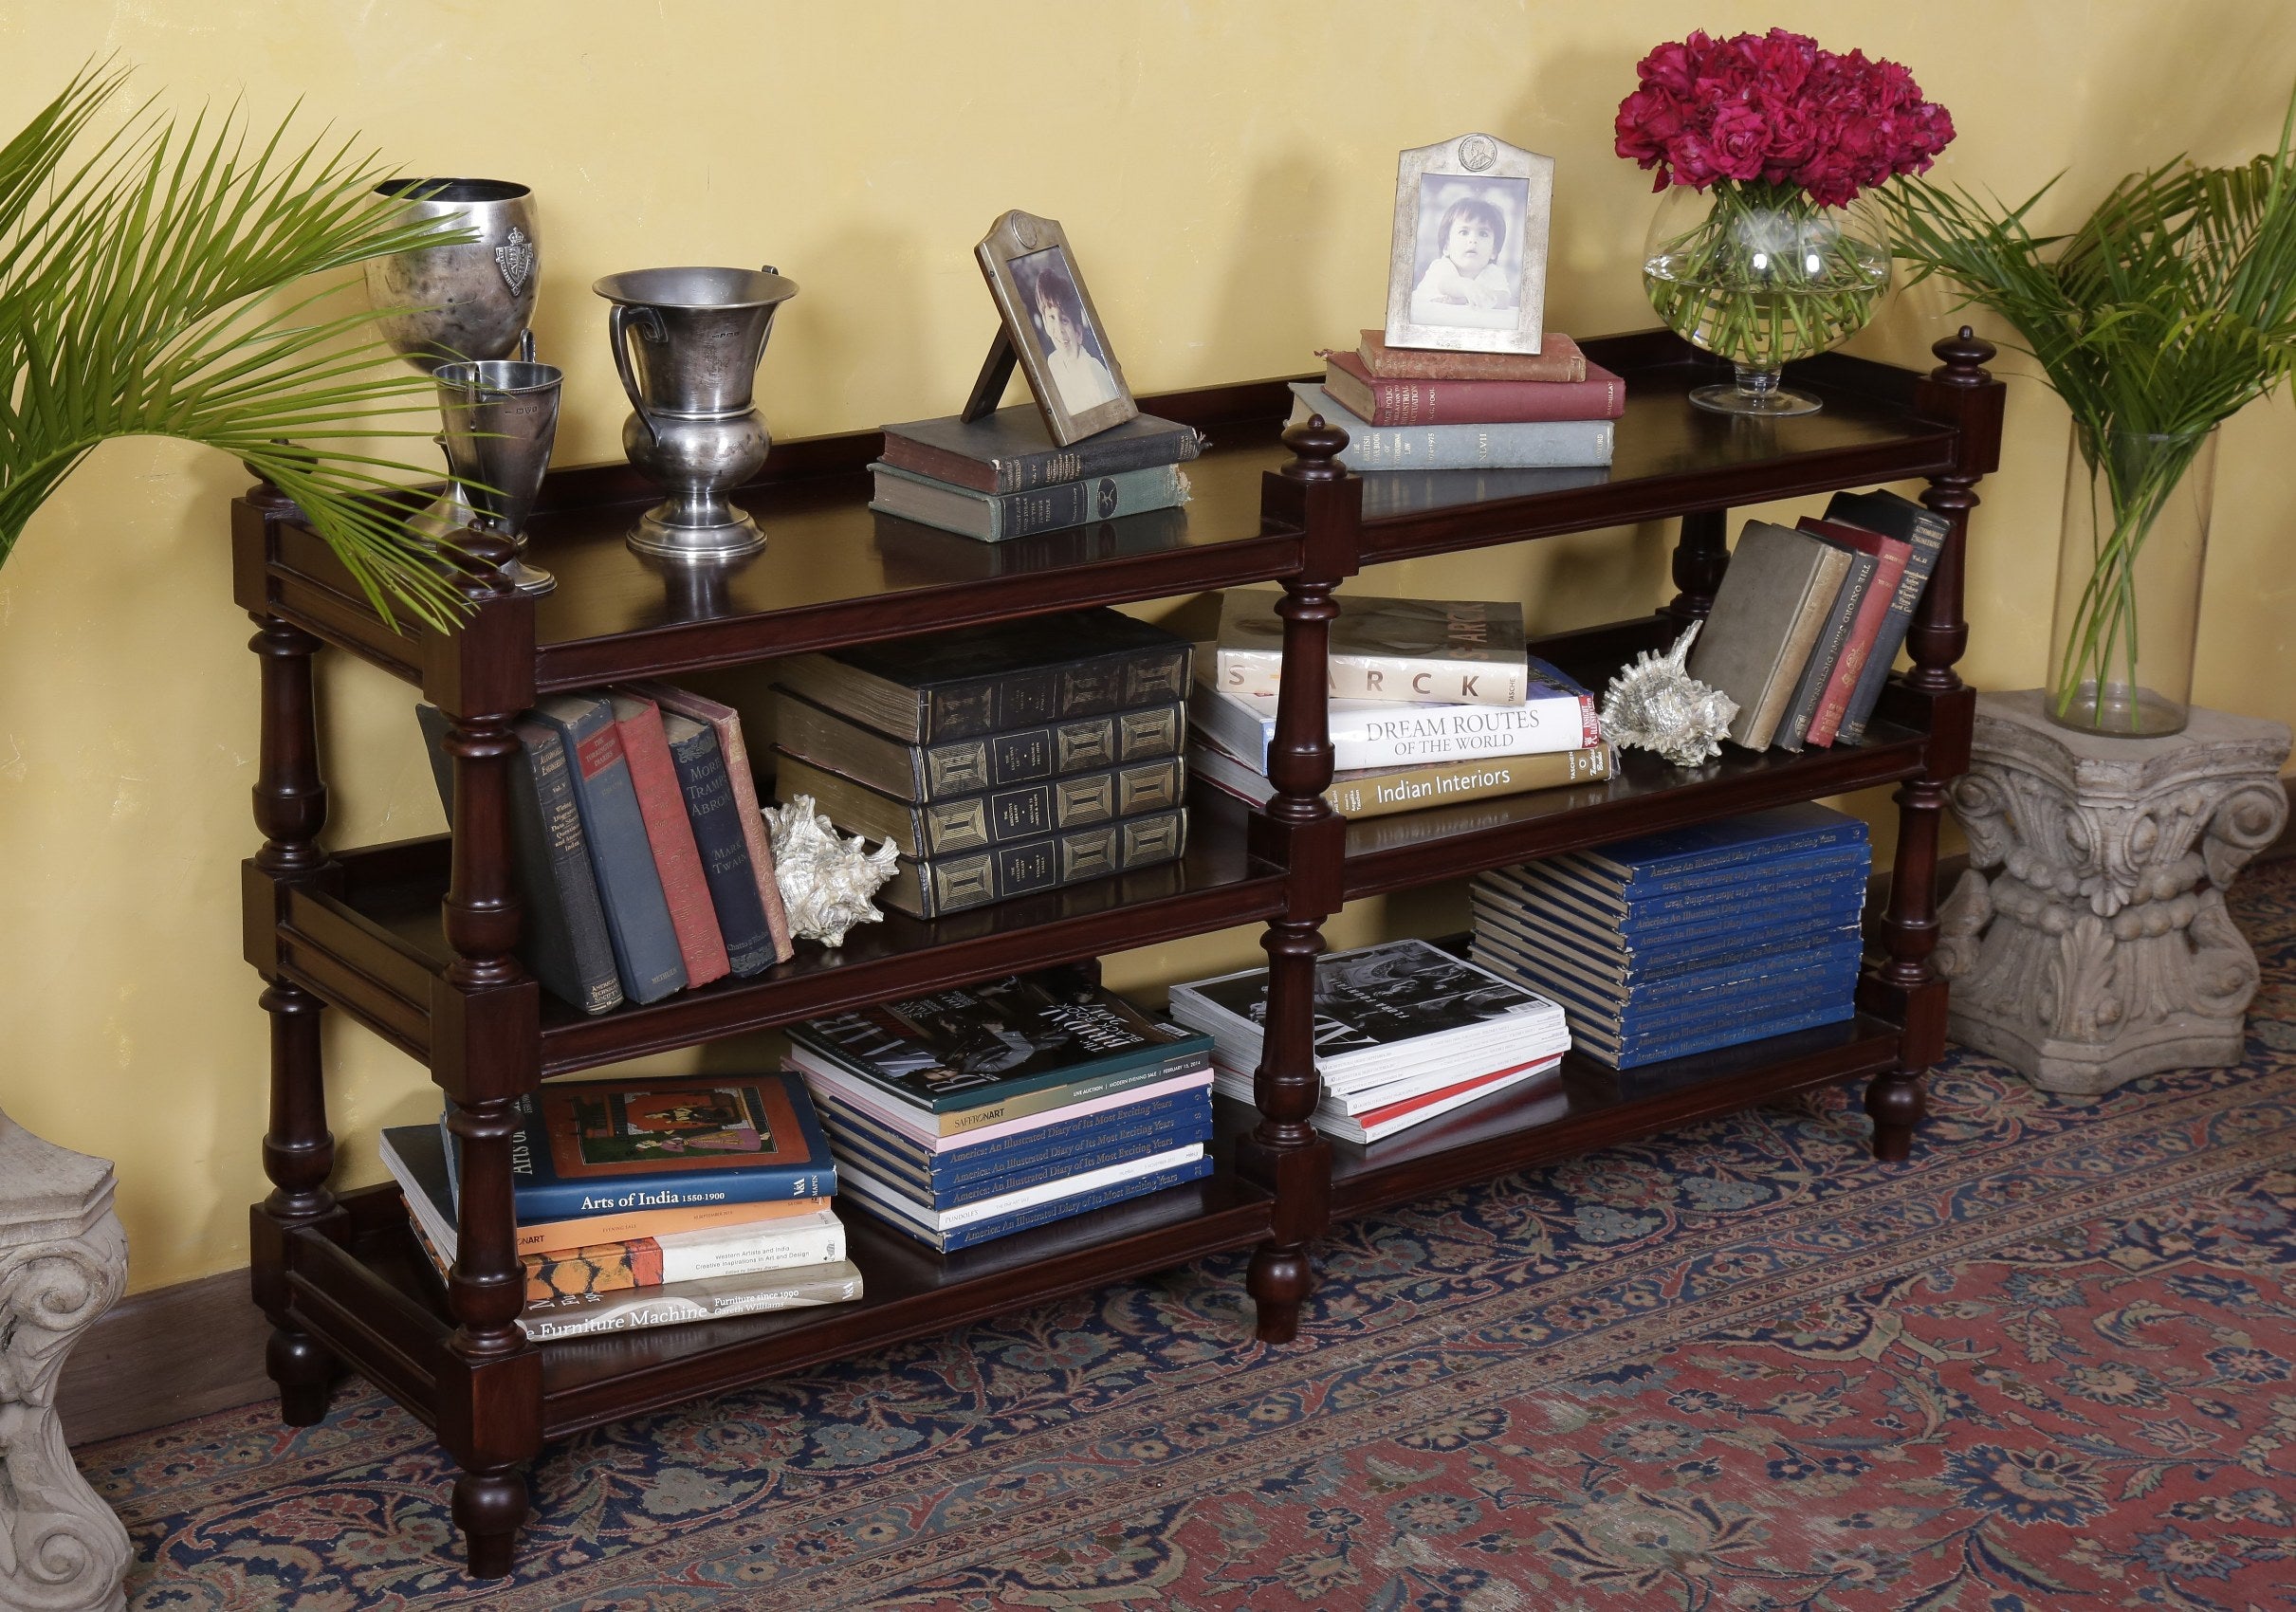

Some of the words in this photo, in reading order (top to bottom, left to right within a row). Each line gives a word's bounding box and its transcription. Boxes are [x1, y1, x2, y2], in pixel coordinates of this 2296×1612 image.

[1858, 564, 1871, 584] THE
[1843, 585, 1863, 623] OXFORD
[1366, 717, 1445, 742] DREAM
[1453, 708, 1540, 734] ROUTES
[1581, 705, 1591, 728] INSIGHT
[1394, 742, 1416, 756] OF
[1419, 739, 1452, 753] THE
[1456, 733, 1514, 750] WORLD
[691, 758, 721, 781] MORE
[1377, 779, 1432, 804] Indian
[1436, 769, 1511, 794] Interiors
[690, 791, 730, 816] ABROA
[712, 841, 743, 860] MARK
[712, 854, 746, 874] TWAIN
[1329, 979, 1377, 1003] FOUNTAIN
[1061, 1002, 1099, 1023] BOOK
[1375, 1003, 1410, 1018] FLORA
[1038, 1004, 1132, 1048] BRIDAL
[1096, 1022, 1145, 1044] BLACK
[806, 1013, 988, 1092] BZAAR
[954, 1108, 1005, 1128] SAFFRONART
[1082, 1085, 1104, 1095] AUCTION
[1109, 1079, 1128, 1088] MODERN
[1128, 1074, 1147, 1084] EVENING
[1147, 1071, 1157, 1079] SALE
[1163, 1065, 1183, 1074] FEBRUARY
[949, 1147, 986, 1163] America:
[988, 1144, 1002, 1153] An
[1003, 1129, 1046, 1149] Illustrated
[1046, 1127, 1071, 1138] Diary
[1071, 1121, 1082, 1132] of
[1081, 1121, 1093, 1129] Its
[1094, 1112, 1116, 1126] Most
[1117, 1106, 1151, 1120] Exciting
[1152, 1101, 1172, 1111] Years
[512, 1145, 533, 1175] Arts
[952, 1167, 991, 1183] America:
[992, 1163, 1004, 1173] An
[1005, 1149, 1049, 1169] Illustrated
[1051, 1145, 1075, 1158] Diary
[1075, 1140, 1085, 1151] of
[1085, 1140, 1095, 1149] Its
[1097, 1132, 1117, 1145] Most
[1119, 1126, 1153, 1140] Exciting
[1154, 1120, 1174, 1131] Years
[952, 1187, 989, 1202] America:
[991, 1183, 1005, 1193] An
[1006, 1168, 1049, 1188] Illustrated
[1050, 1164, 1074, 1177] Diary
[1074, 1160, 1083, 1170] of
[1096, 1151, 1116, 1164] Most
[1118, 1145, 1150, 1159] Exciting
[1152, 1139, 1173, 1149] Years
[793, 1178, 805, 1197] V&A
[580, 1196, 615, 1210] Arts
[618, 1193, 636, 1207] of
[637, 1191, 679, 1206] India
[517, 1235, 545, 1246] ONART
[695, 1262, 721, 1271] Creative
[722, 1257, 757, 1269] Inspirations
[789, 1251, 810, 1259] Design
[715, 1252, 741, 1260] Western
[714, 1294, 755, 1307] Furniture
[756, 1291, 779, 1300] since
[780, 1290, 799, 1298] 1990
[842, 1282, 854, 1300] V&A
[714, 1305, 744, 1316] Gareth
[745, 1301, 784, 1311] Williams
[540, 1318, 625, 1338] Furniture
[630, 1304, 707, 1328] Machine
